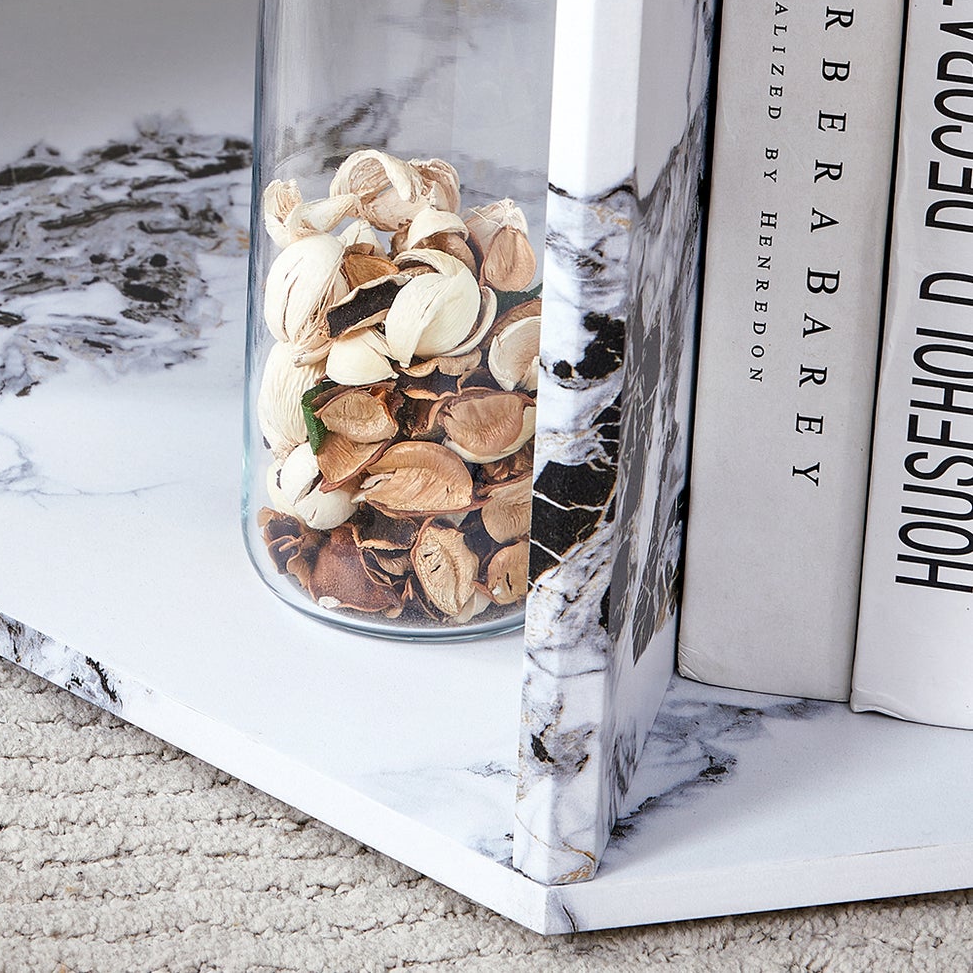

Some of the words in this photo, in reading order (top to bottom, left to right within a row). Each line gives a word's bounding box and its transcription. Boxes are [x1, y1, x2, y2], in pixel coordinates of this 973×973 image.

[763, 147, 779, 183] BY
[749, 210, 778, 383] HENREDON
[791, 266, 841, 487] BAREY
